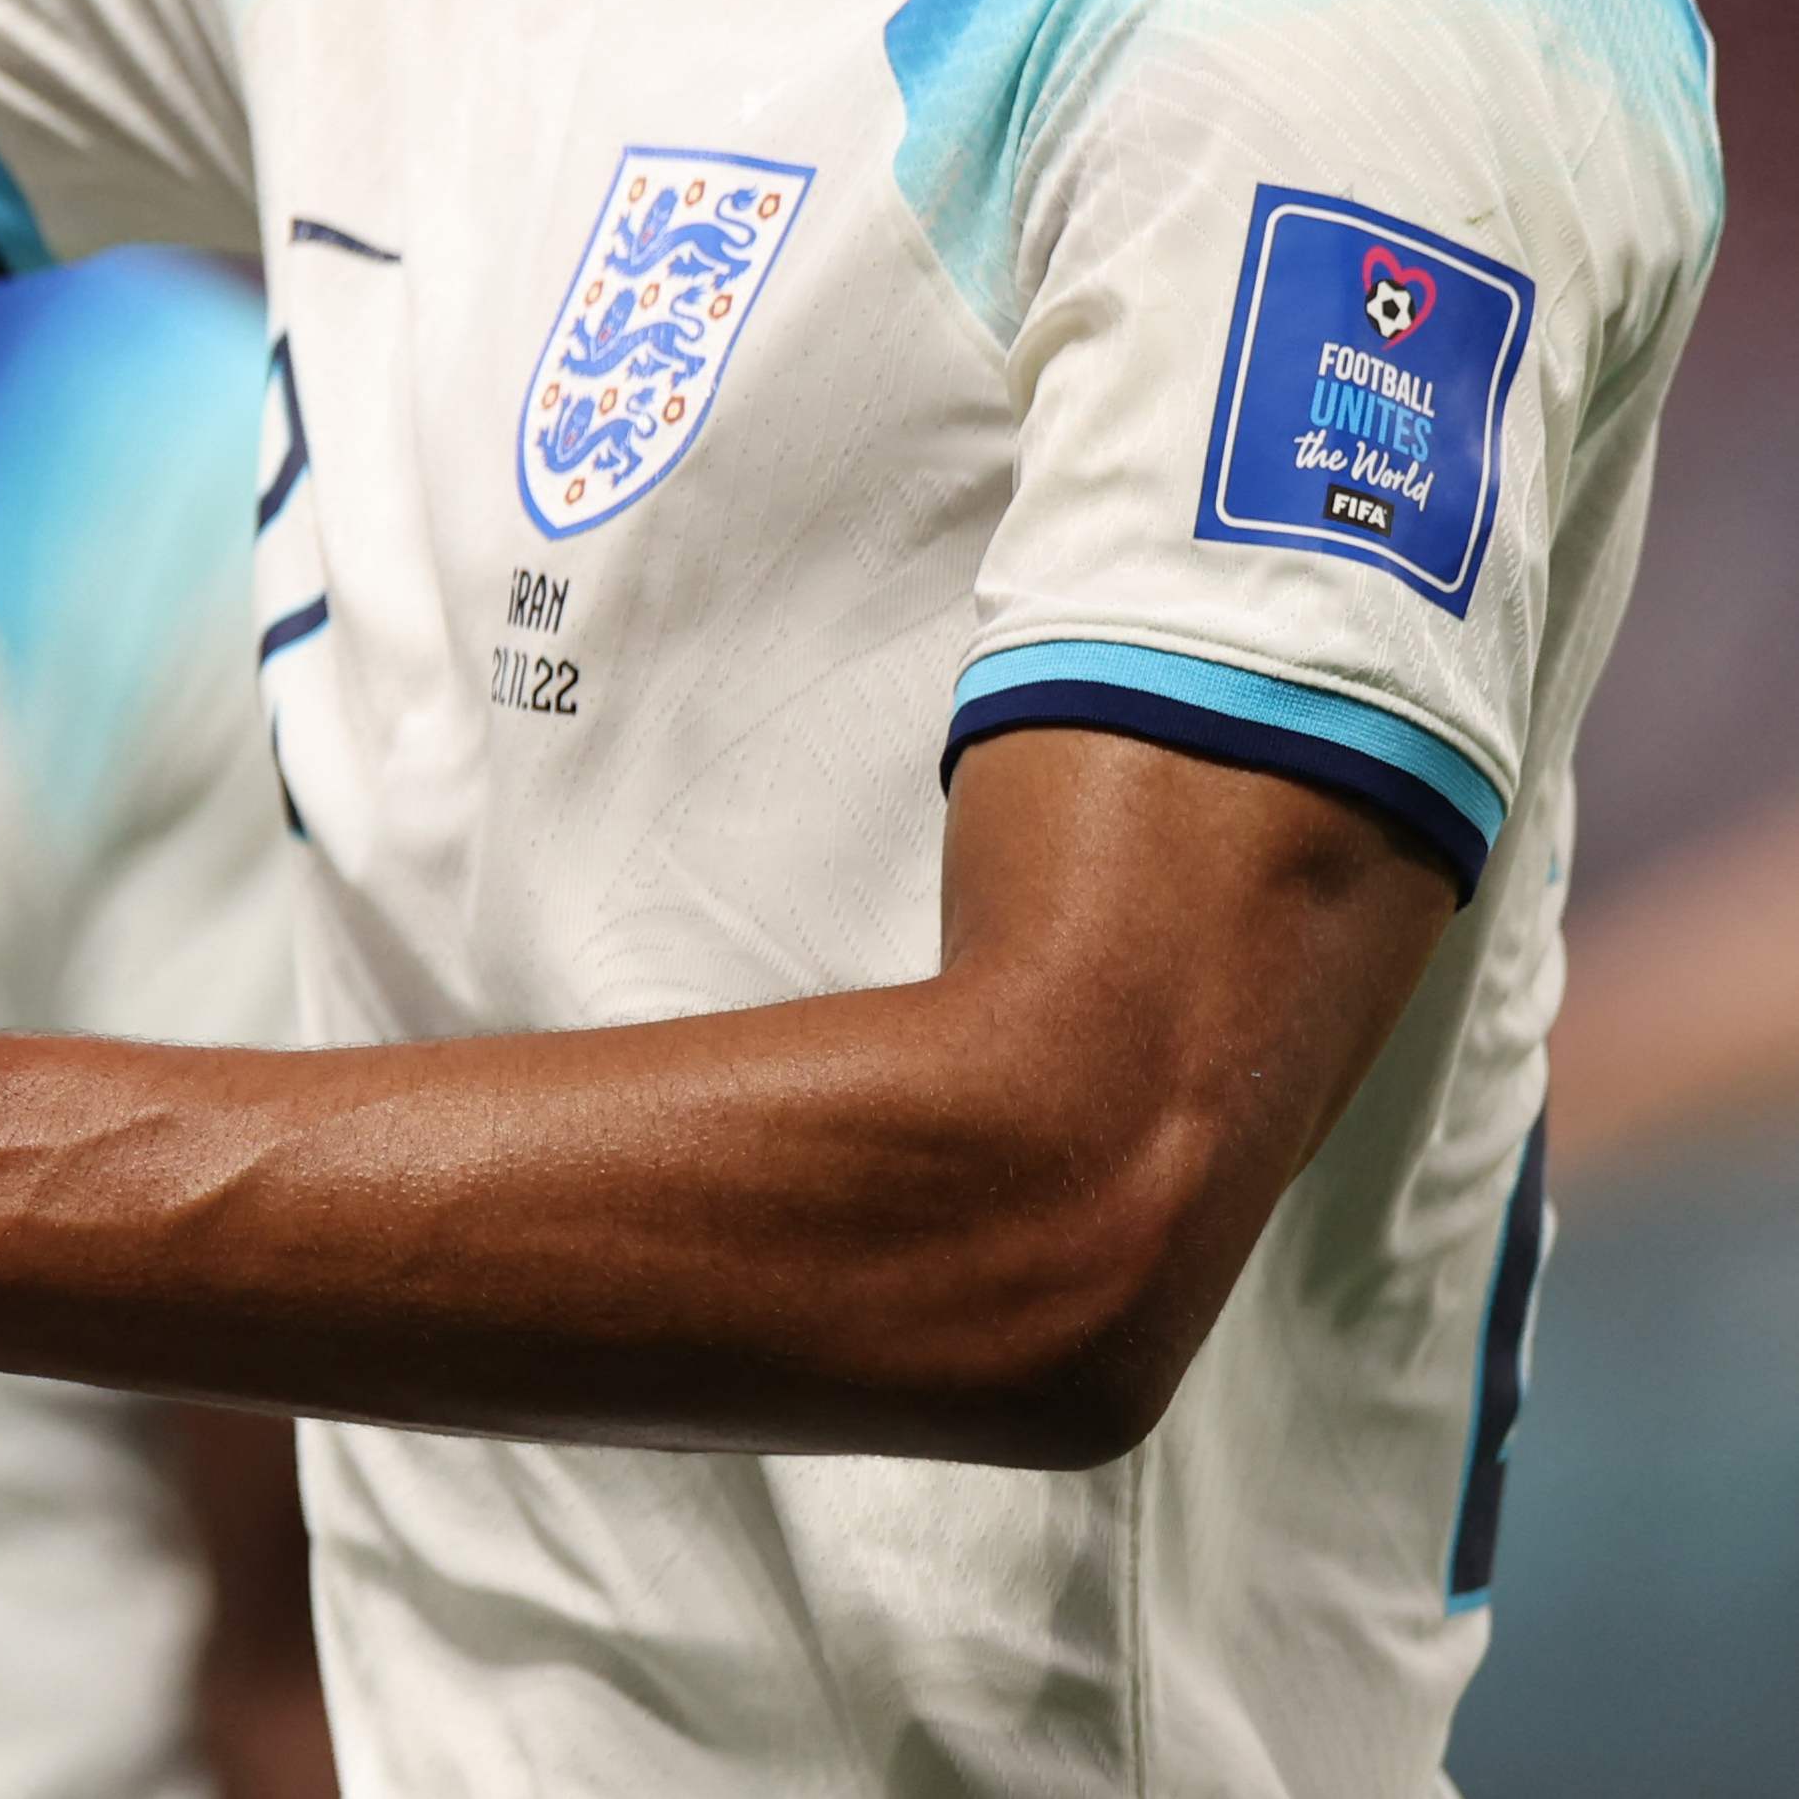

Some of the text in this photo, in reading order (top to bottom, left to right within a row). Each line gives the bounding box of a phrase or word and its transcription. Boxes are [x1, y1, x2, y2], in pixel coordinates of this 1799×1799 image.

[1318, 342, 1435, 418] FOOTBALL
[1310, 379, 1432, 463] UNITES
[1293, 429, 1434, 512] the World
[1332, 492, 1387, 529] FIFA
[507, 566, 570, 636] IRAN
